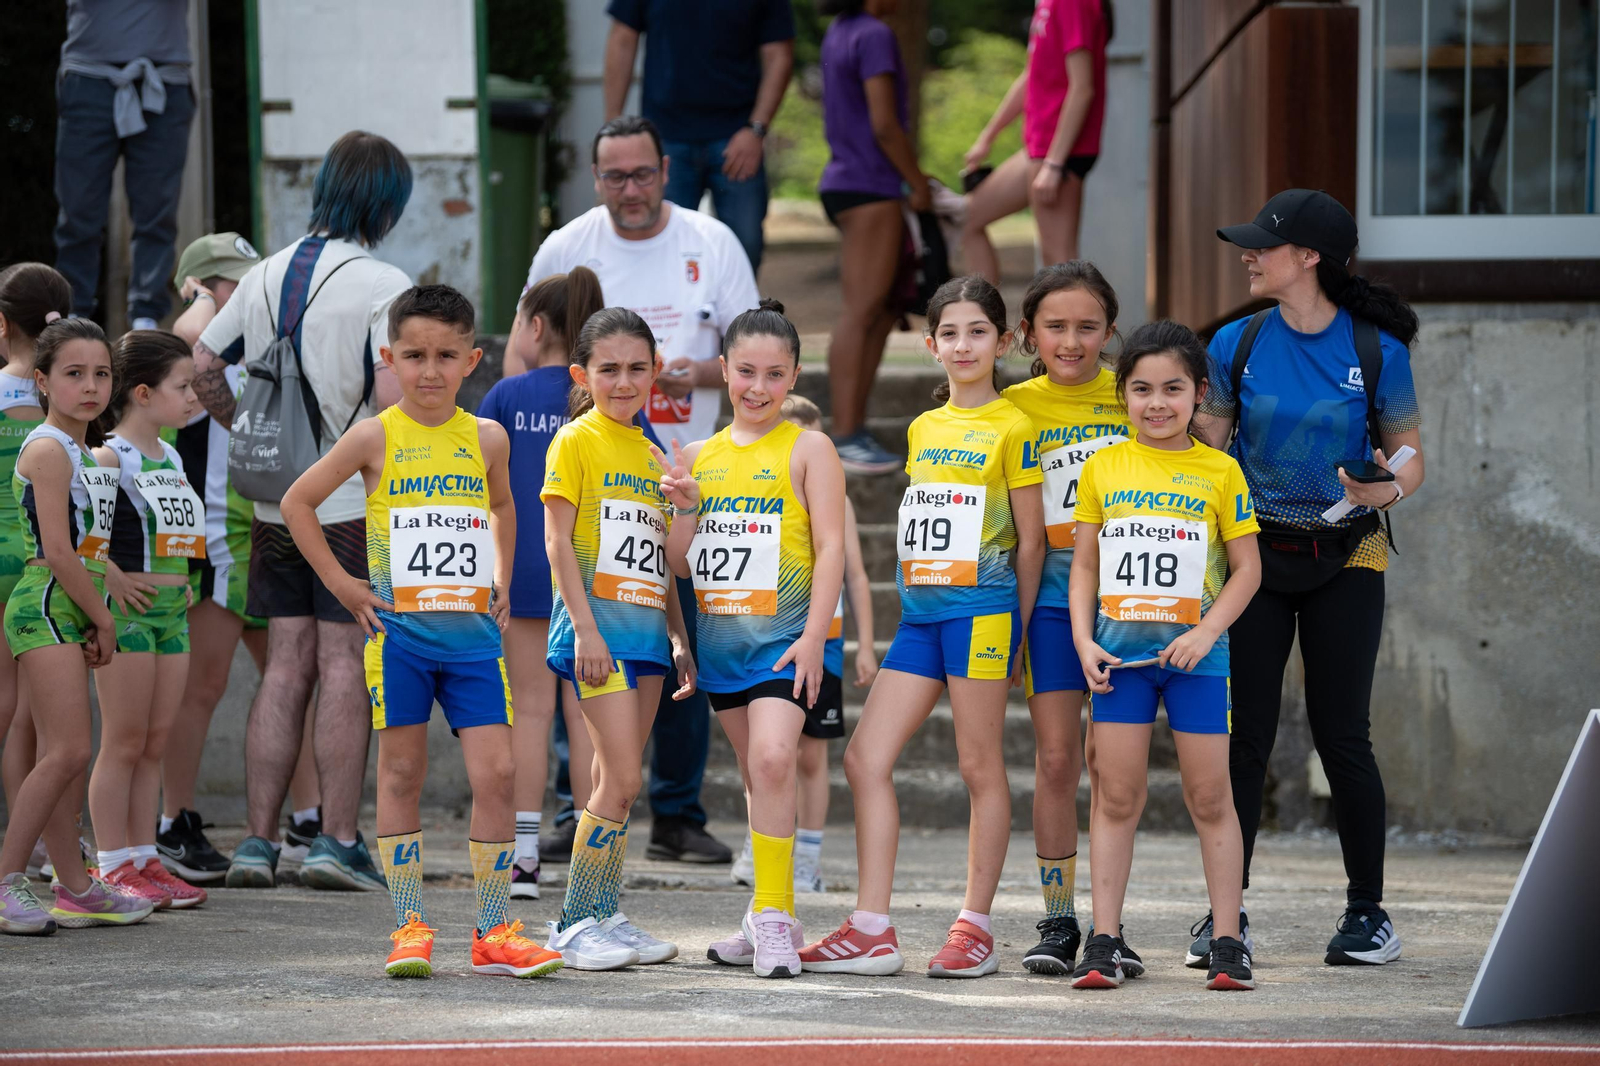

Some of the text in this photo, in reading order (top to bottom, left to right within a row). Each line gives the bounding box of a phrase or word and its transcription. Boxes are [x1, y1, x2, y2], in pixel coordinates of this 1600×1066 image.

[530, 412, 548, 433] LA
[404, 446, 432, 454] ARRANZ
[404, 453, 432, 462] DENTAL
[453, 452, 473, 460] amura
[915, 448, 987, 466] LIMIACTIVA
[83, 473, 102, 486] La
[135, 477, 157, 489] La
[388, 474, 485, 498] LIMIACTIVA
[915, 489, 978, 509] Región
[1103, 489, 1208, 515] LIMIACTIVA
[157, 497, 196, 528] 558
[391, 512, 489, 532] La Región
[603, 505, 632, 522] La
[704, 519, 773, 538] Región
[904, 517, 952, 552] 419
[1100, 522, 1201, 543] La Región
[406, 541, 477, 578] 423
[613, 535, 667, 579] 420
[695, 547, 752, 582] 427
[1115, 551, 1179, 588] 418
[417, 596, 476, 612] telemiño
[1119, 607, 1178, 622] telemiño
[975, 652, 1004, 660] amura
[393, 840, 420, 866] LA
[1040, 865, 1063, 887] LA
